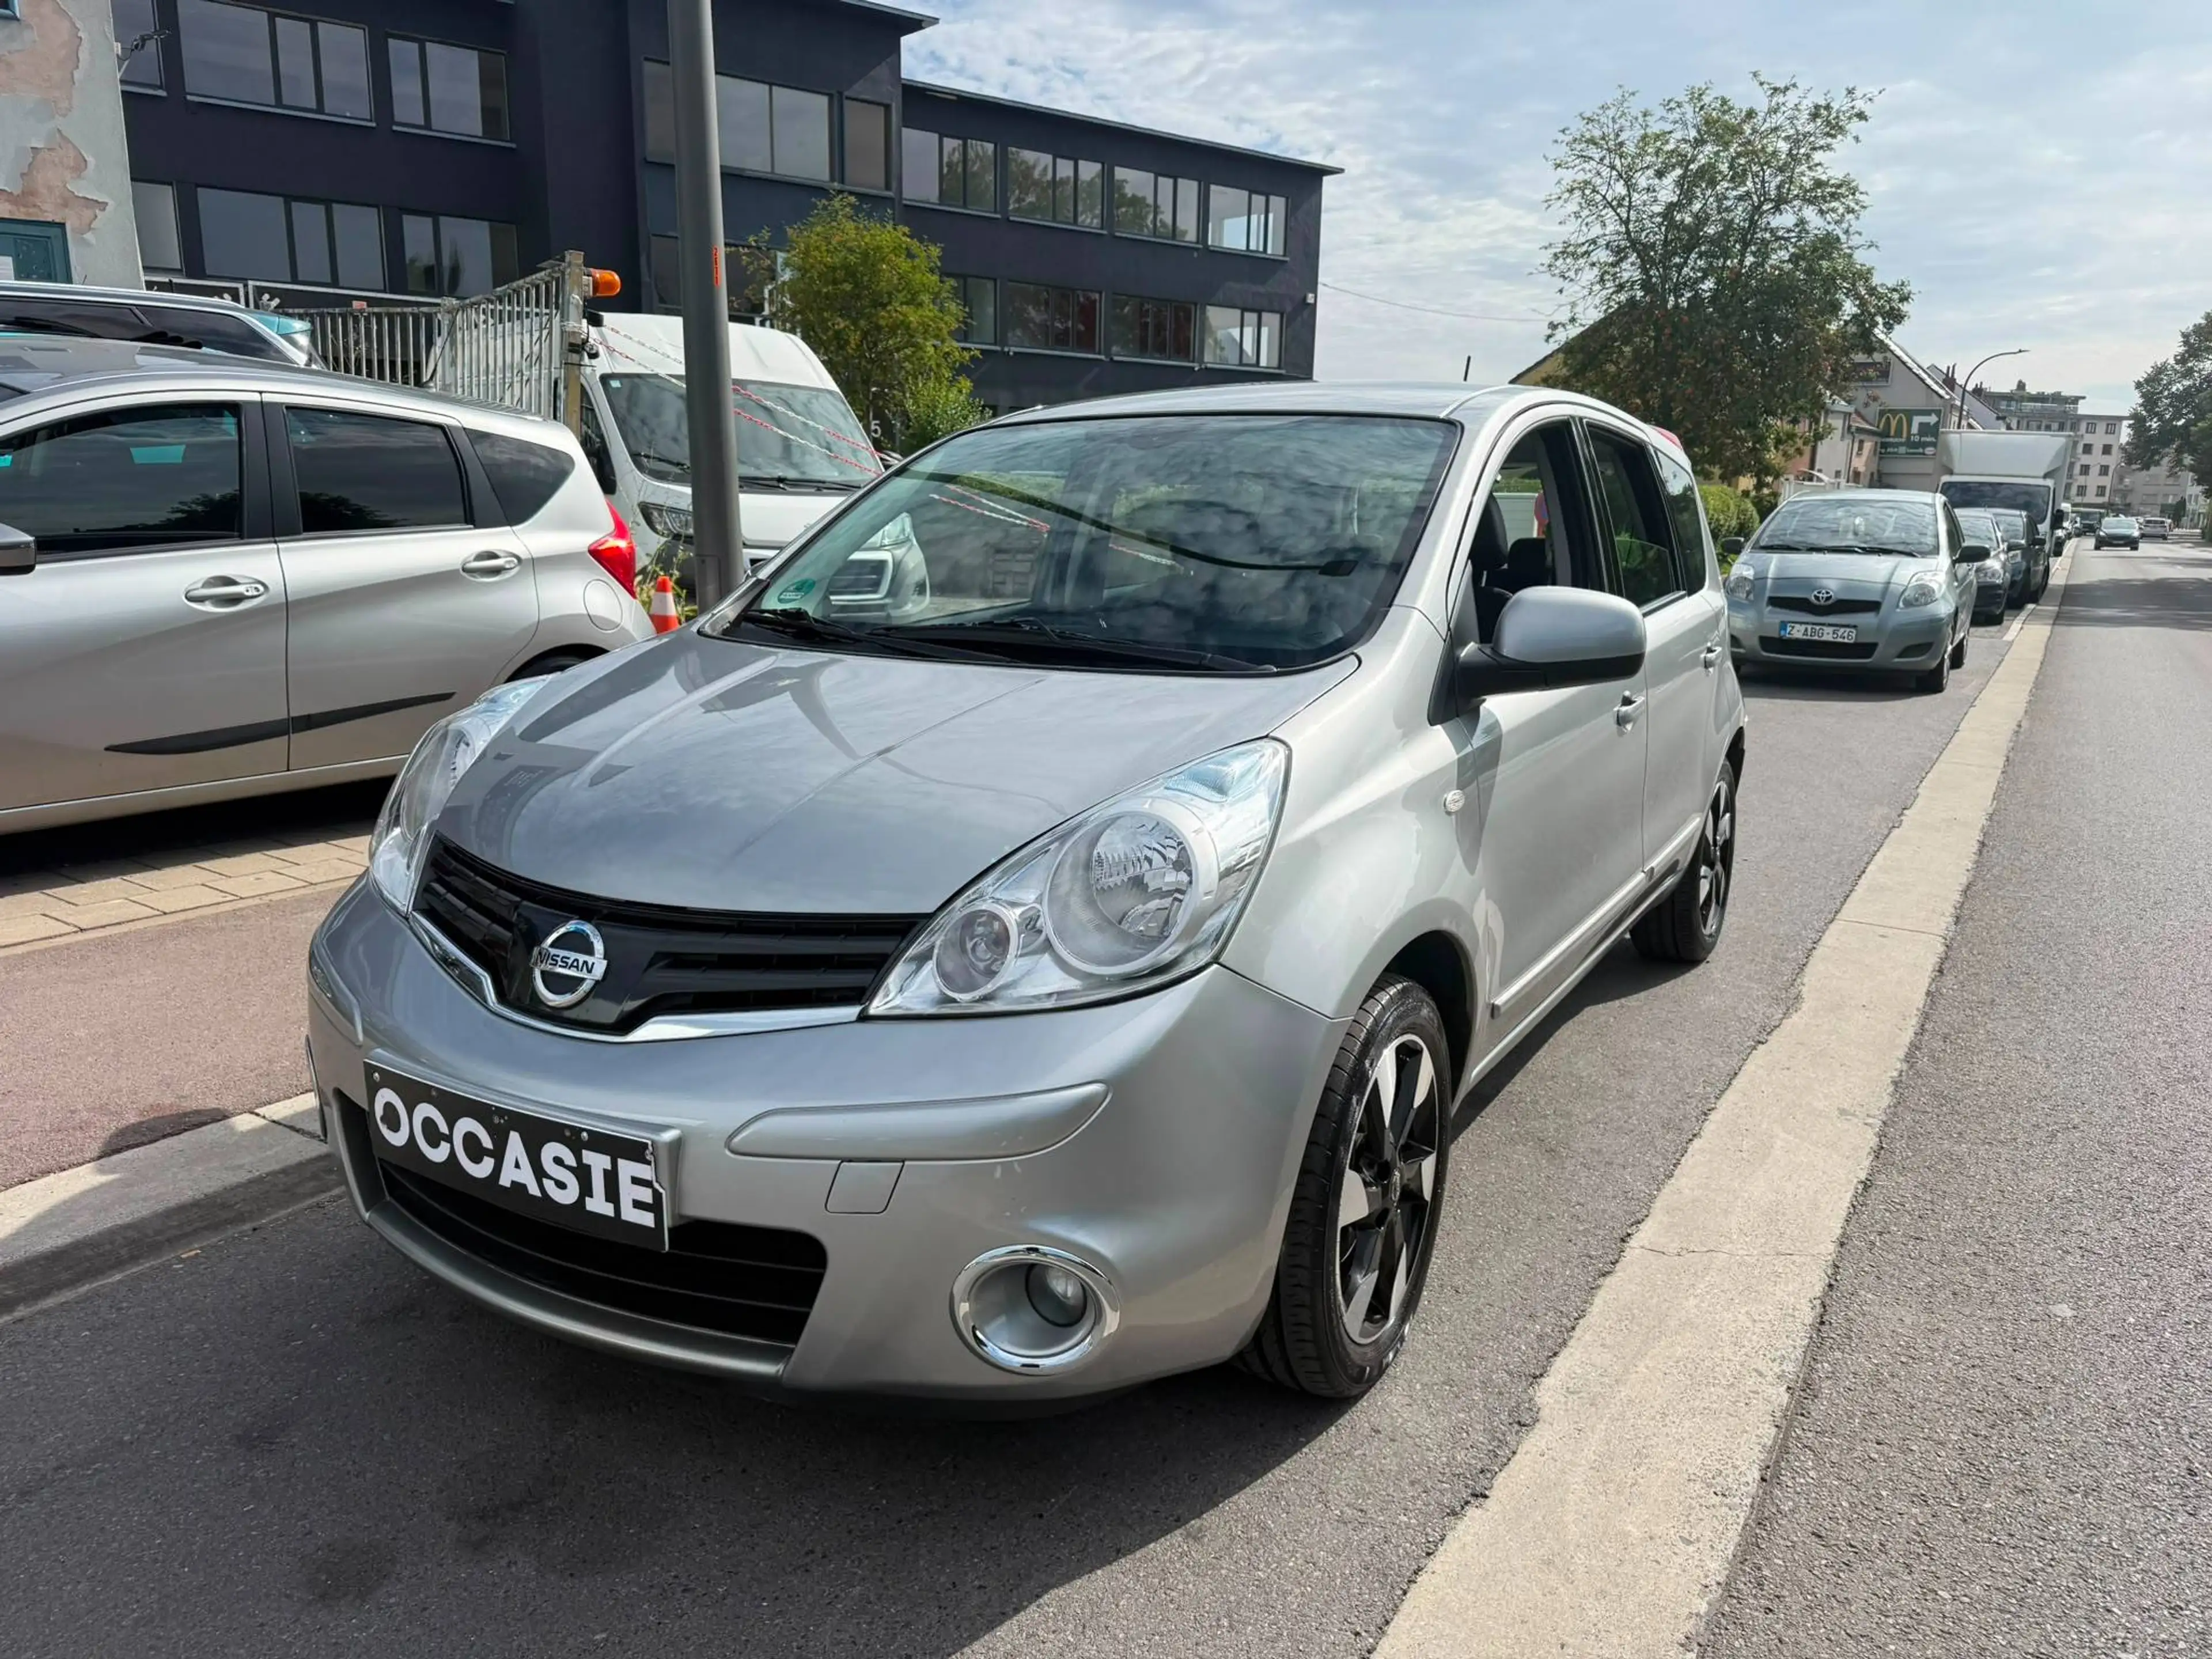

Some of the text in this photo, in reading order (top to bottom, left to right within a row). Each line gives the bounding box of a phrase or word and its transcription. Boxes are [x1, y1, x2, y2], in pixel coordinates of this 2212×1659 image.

[871, 420, 881, 437] 5
[535, 949, 595, 974] NISSAN
[374, 1088, 656, 1228] OCCASIE
